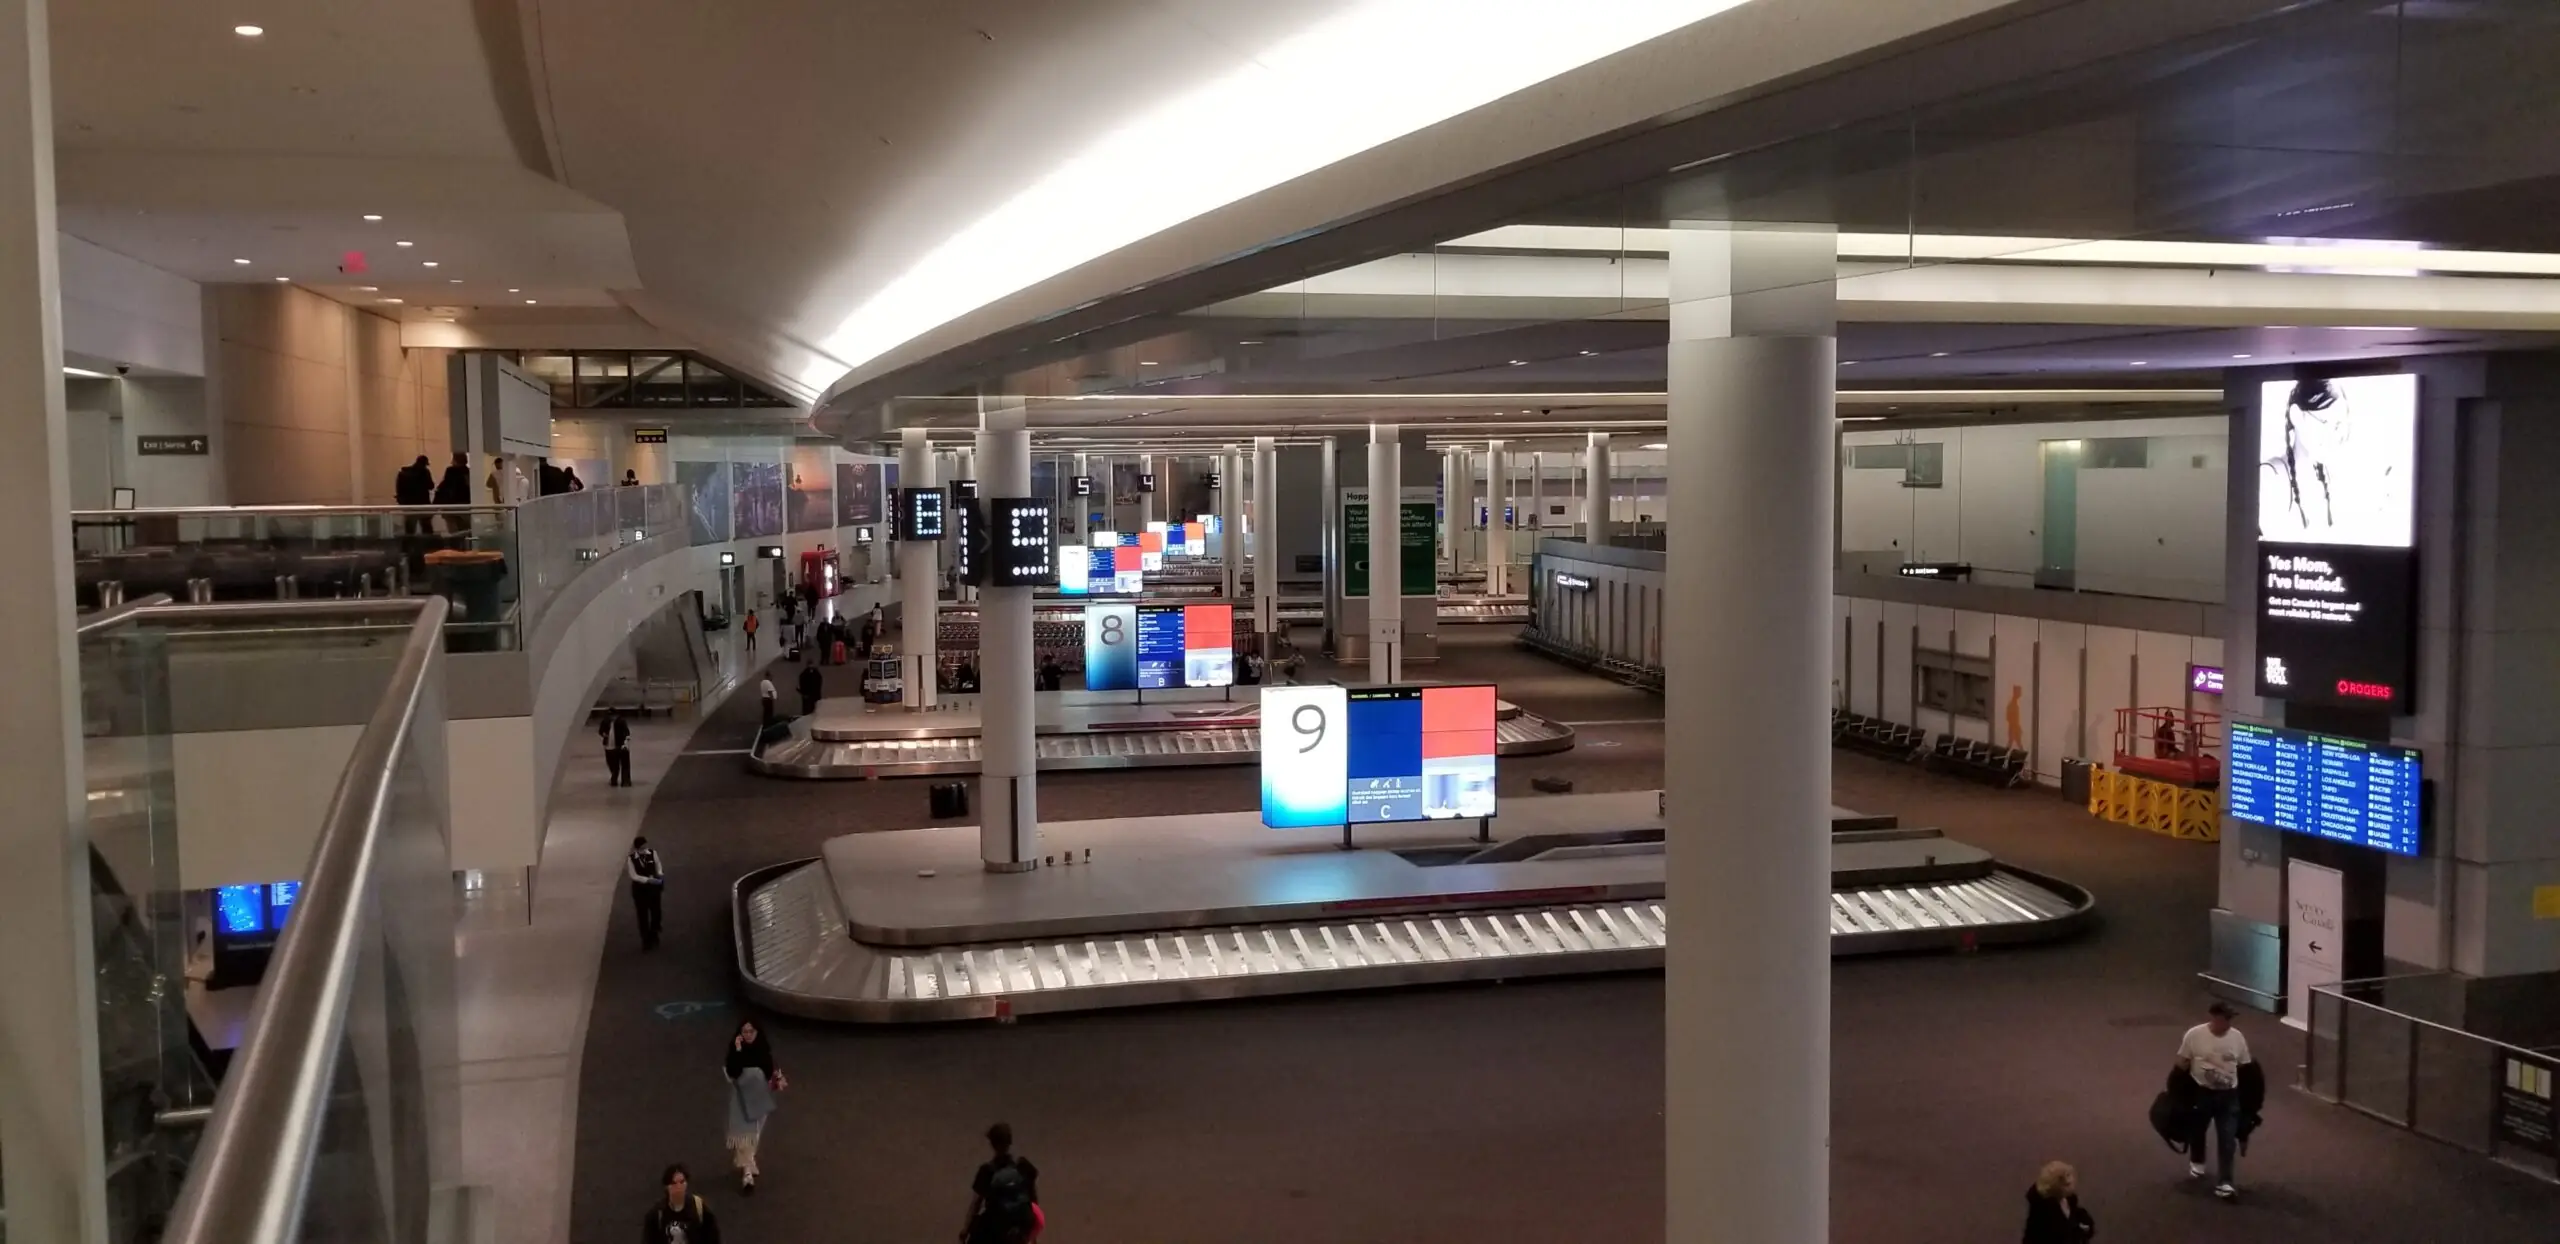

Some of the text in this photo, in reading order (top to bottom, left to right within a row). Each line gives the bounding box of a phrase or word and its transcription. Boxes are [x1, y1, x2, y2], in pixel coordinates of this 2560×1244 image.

[1077, 477, 1090, 495] 5
[1143, 475, 1153, 491] 4
[1211, 474, 1221, 488] 3
[916, 493, 941, 535] 8
[1011, 507, 1049, 576] 9
[2268, 555, 2333, 575] Yes Mom,
[2268, 572, 2346, 592] I've landed.
[2268, 597, 2281, 606] Get
[2291, 598, 2320, 608] Canada's
[2321, 599, 2344, 611] largest
[2345, 602, 2361, 611] and
[2286, 608, 2310, 619] reliable
[2311, 610, 2321, 619] 5G
[1101, 615, 1124, 645] 8
[2350, 682, 2390, 698] ROGERS
[1292, 704, 1326, 754] 9
[2232, 744, 2253, 752] DETROIT
[2322, 749, 2334, 757] NEW
[1381, 804, 1391, 819] C
[2302, 911, 2335, 932] Canada
